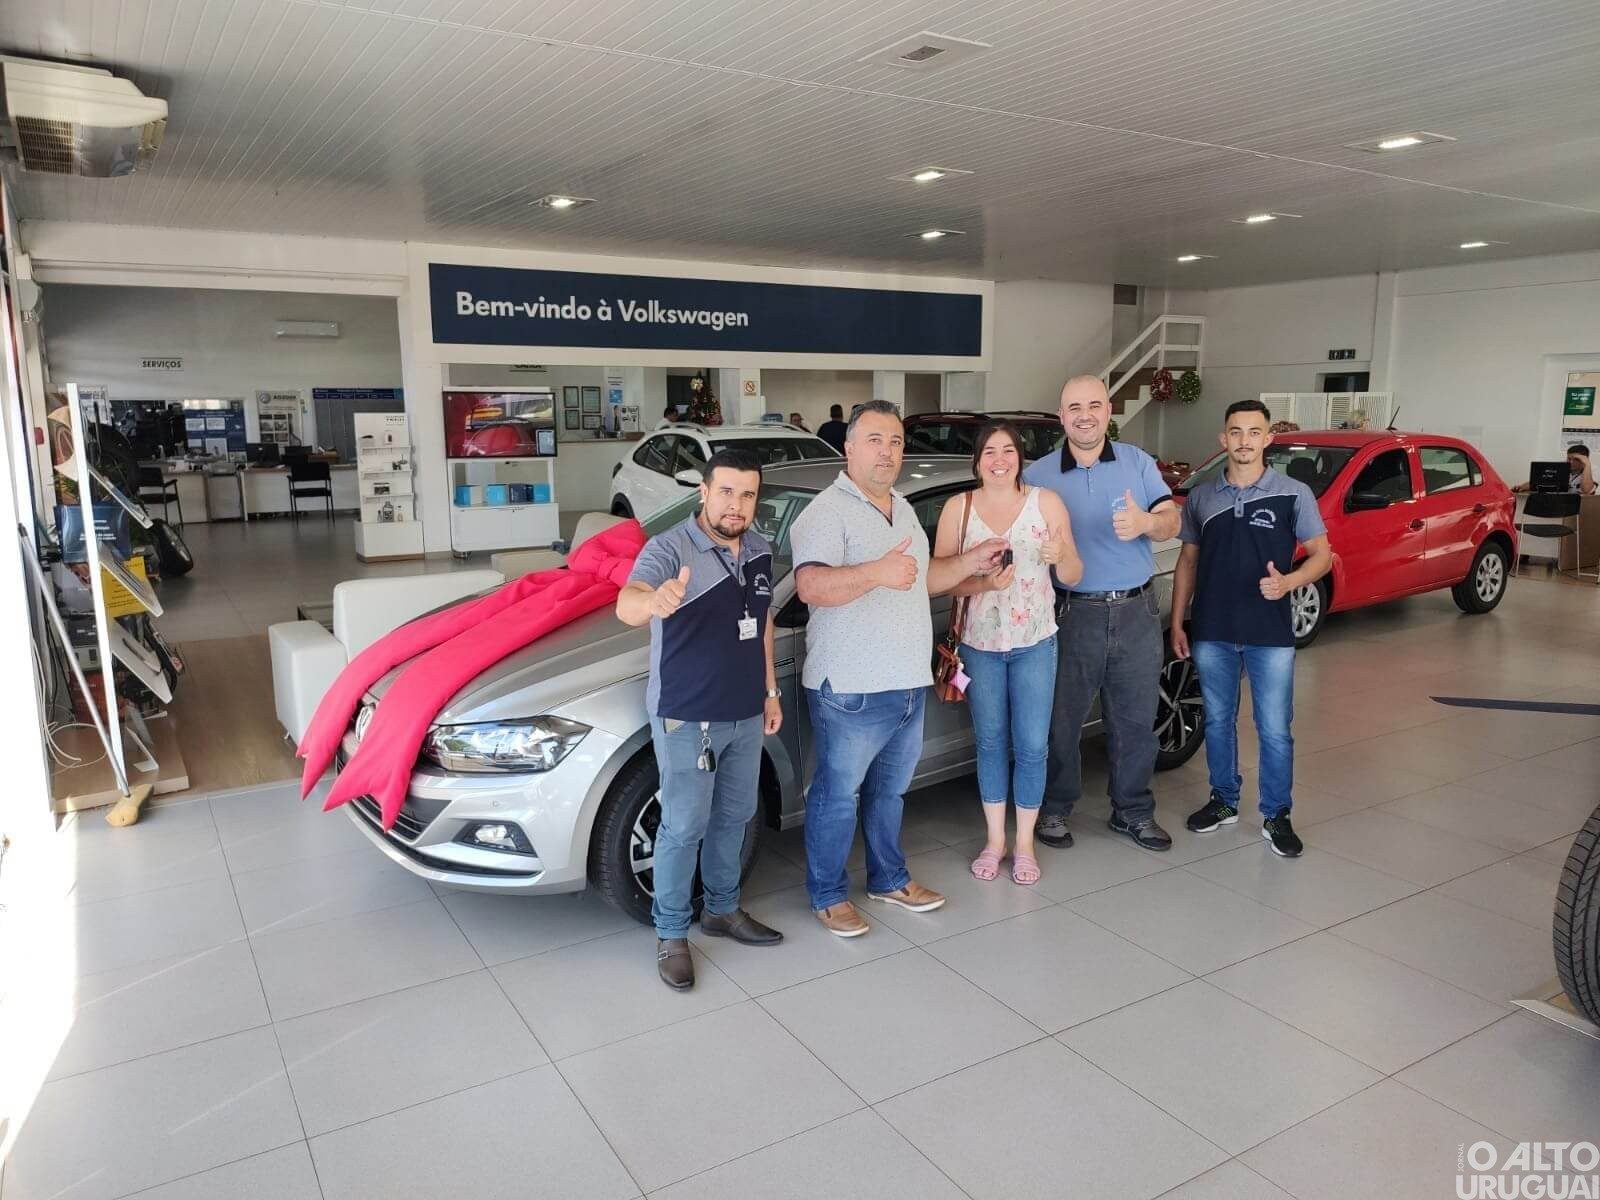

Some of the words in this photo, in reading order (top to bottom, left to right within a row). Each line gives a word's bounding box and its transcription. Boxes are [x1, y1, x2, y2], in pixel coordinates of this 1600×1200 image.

[456, 291, 591, 321] Bem-vindo
[597, 298, 612, 322] à
[617, 299, 750, 331] Volkswagen
[142, 360, 181, 370] SERVIÇOS
